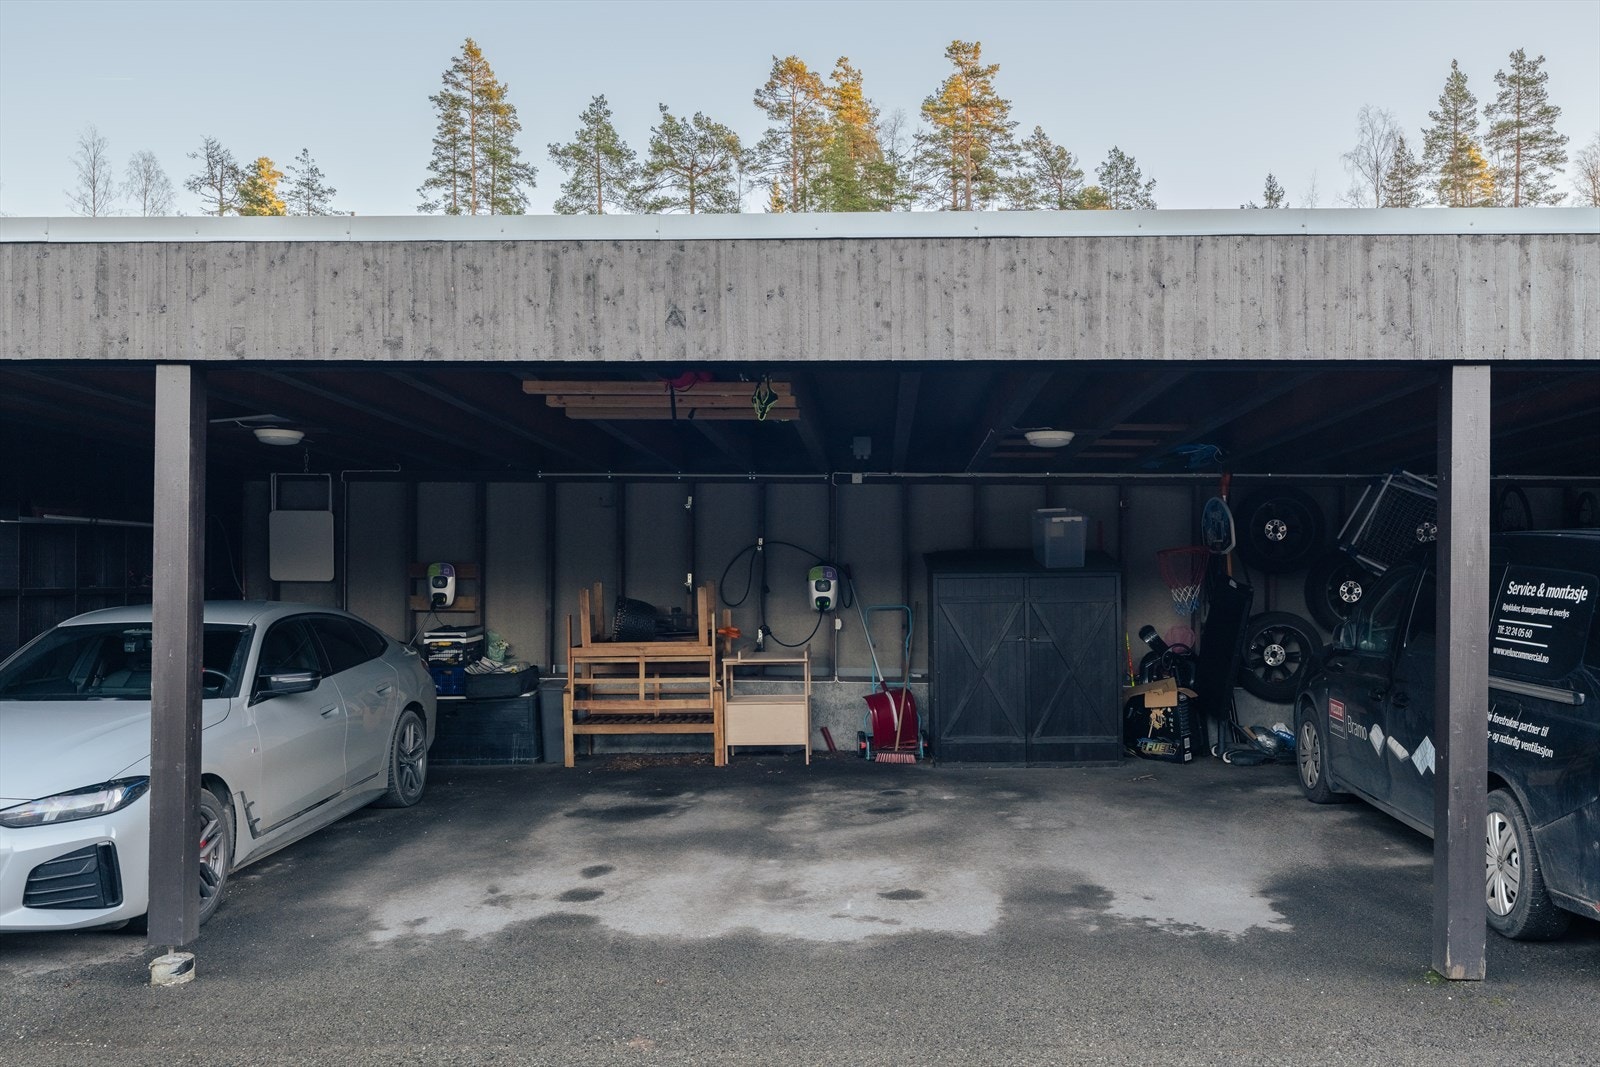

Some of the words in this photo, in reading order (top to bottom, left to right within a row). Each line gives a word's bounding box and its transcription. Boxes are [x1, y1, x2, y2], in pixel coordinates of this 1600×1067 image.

[1507, 581, 1537, 597] Service
[1537, 583, 1545, 597] &
[1545, 585, 1588, 604] montasje
[1549, 607, 1553, 616] &
[1553, 608, 1570, 619] overlys
[1504, 626, 1511, 636] 32
[1511, 627, 1518, 636] 24
[1518, 628, 1525, 638] 05
[1525, 629, 1533, 638] 60
[1347, 715, 1367, 741] Bramo
[1493, 712, 1519, 729] foretrukne
[1518, 722, 1541, 734] partner
[1541, 726, 1549, 737] til
[1492, 732, 1500, 744] og
[1500, 735, 1520, 750] naturlig
[1521, 741, 1553, 758] ventilasjon
